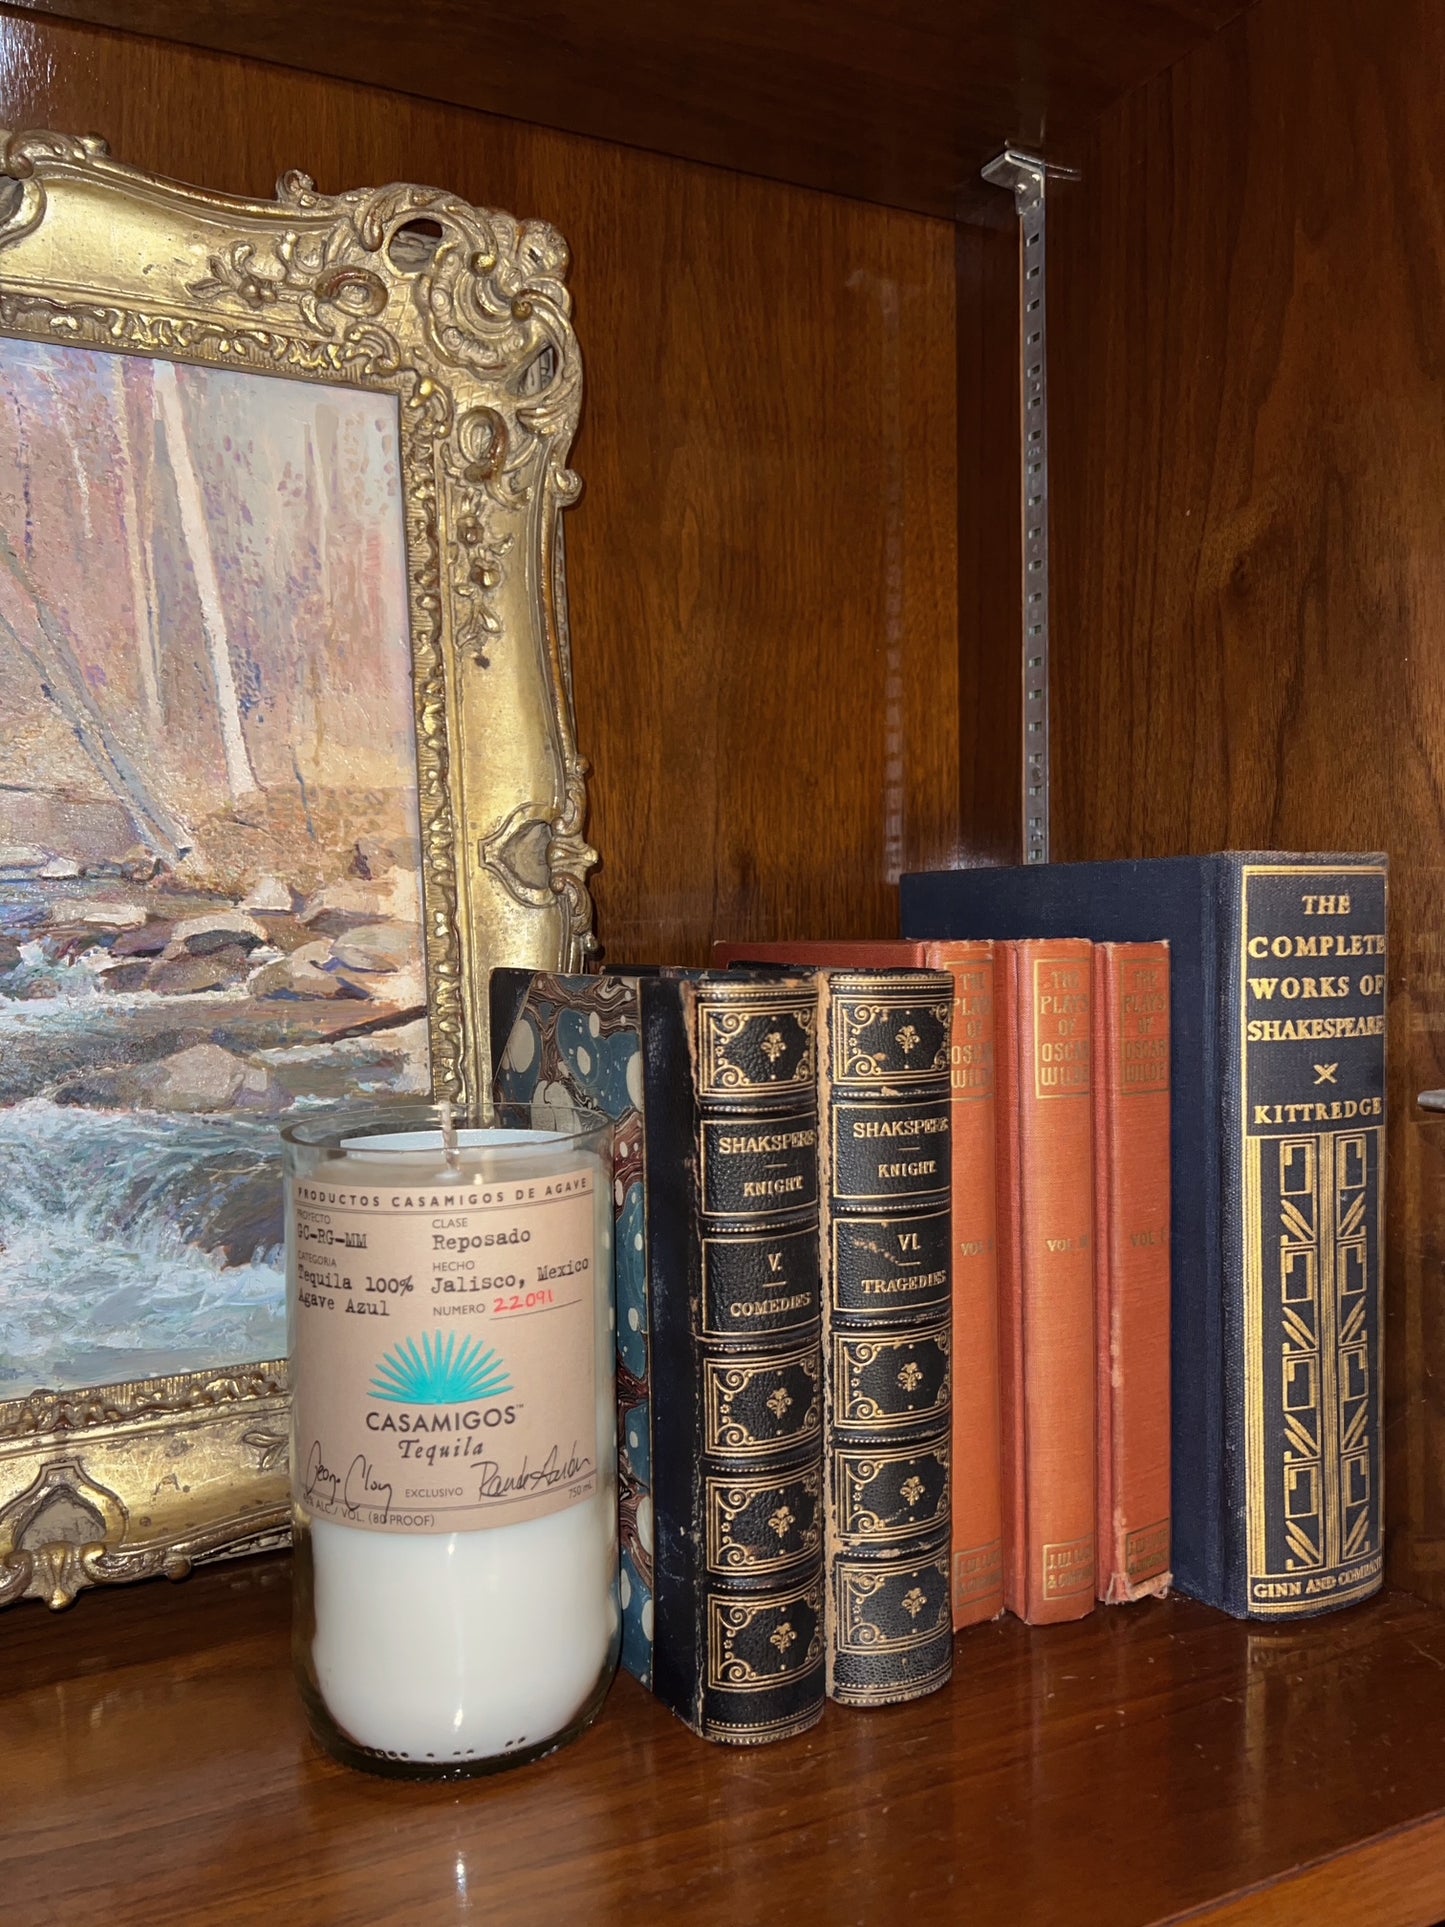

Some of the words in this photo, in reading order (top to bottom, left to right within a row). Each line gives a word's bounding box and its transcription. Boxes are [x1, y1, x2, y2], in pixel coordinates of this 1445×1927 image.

[1302, 895, 1350, 915] THE
[1248, 934, 1384, 958] COMPLETE
[1247, 976, 1349, 999] WORKS
[1359, 974, 1384, 996] OF
[1247, 1014, 1384, 1041] SHAKESPEARE
[1254, 1097, 1382, 1124] KITTREDGE
[878, 1160, 936, 1178] KNIGHT
[298, 1187, 380, 1207] PRODUCTOS
[391, 1191, 504, 1208] CASAMIGOS
[516, 1188, 535, 1201] DE
[545, 1178, 587, 1196] AGAVE
[744, 1175, 804, 1198] KNIGHT
[431, 1217, 468, 1230] CLASE
[432, 1228, 531, 1253] Reposado
[431, 1274, 525, 1294] Jalisco,
[537, 1257, 589, 1282] Mexico
[432, 1260, 475, 1273] HECHO
[298, 1264, 352, 1290] Tequila
[365, 1275, 414, 1296] 100%
[862, 1270, 947, 1295] TRAGEDIES
[298, 1288, 335, 1309] Agave
[345, 1298, 390, 1317] Azul
[433, 1303, 486, 1317] NUMERO
[493, 1289, 554, 1313] 22091
[730, 1292, 811, 1318] COMEDIES
[398, 1436, 484, 1466] Tequila
[405, 1487, 463, 1498] EXCLUSIVO
[390, 1514, 435, 1527] PROOF)
[1253, 1581, 1302, 1598] GINN
[1305, 1575, 1337, 1594] AND
